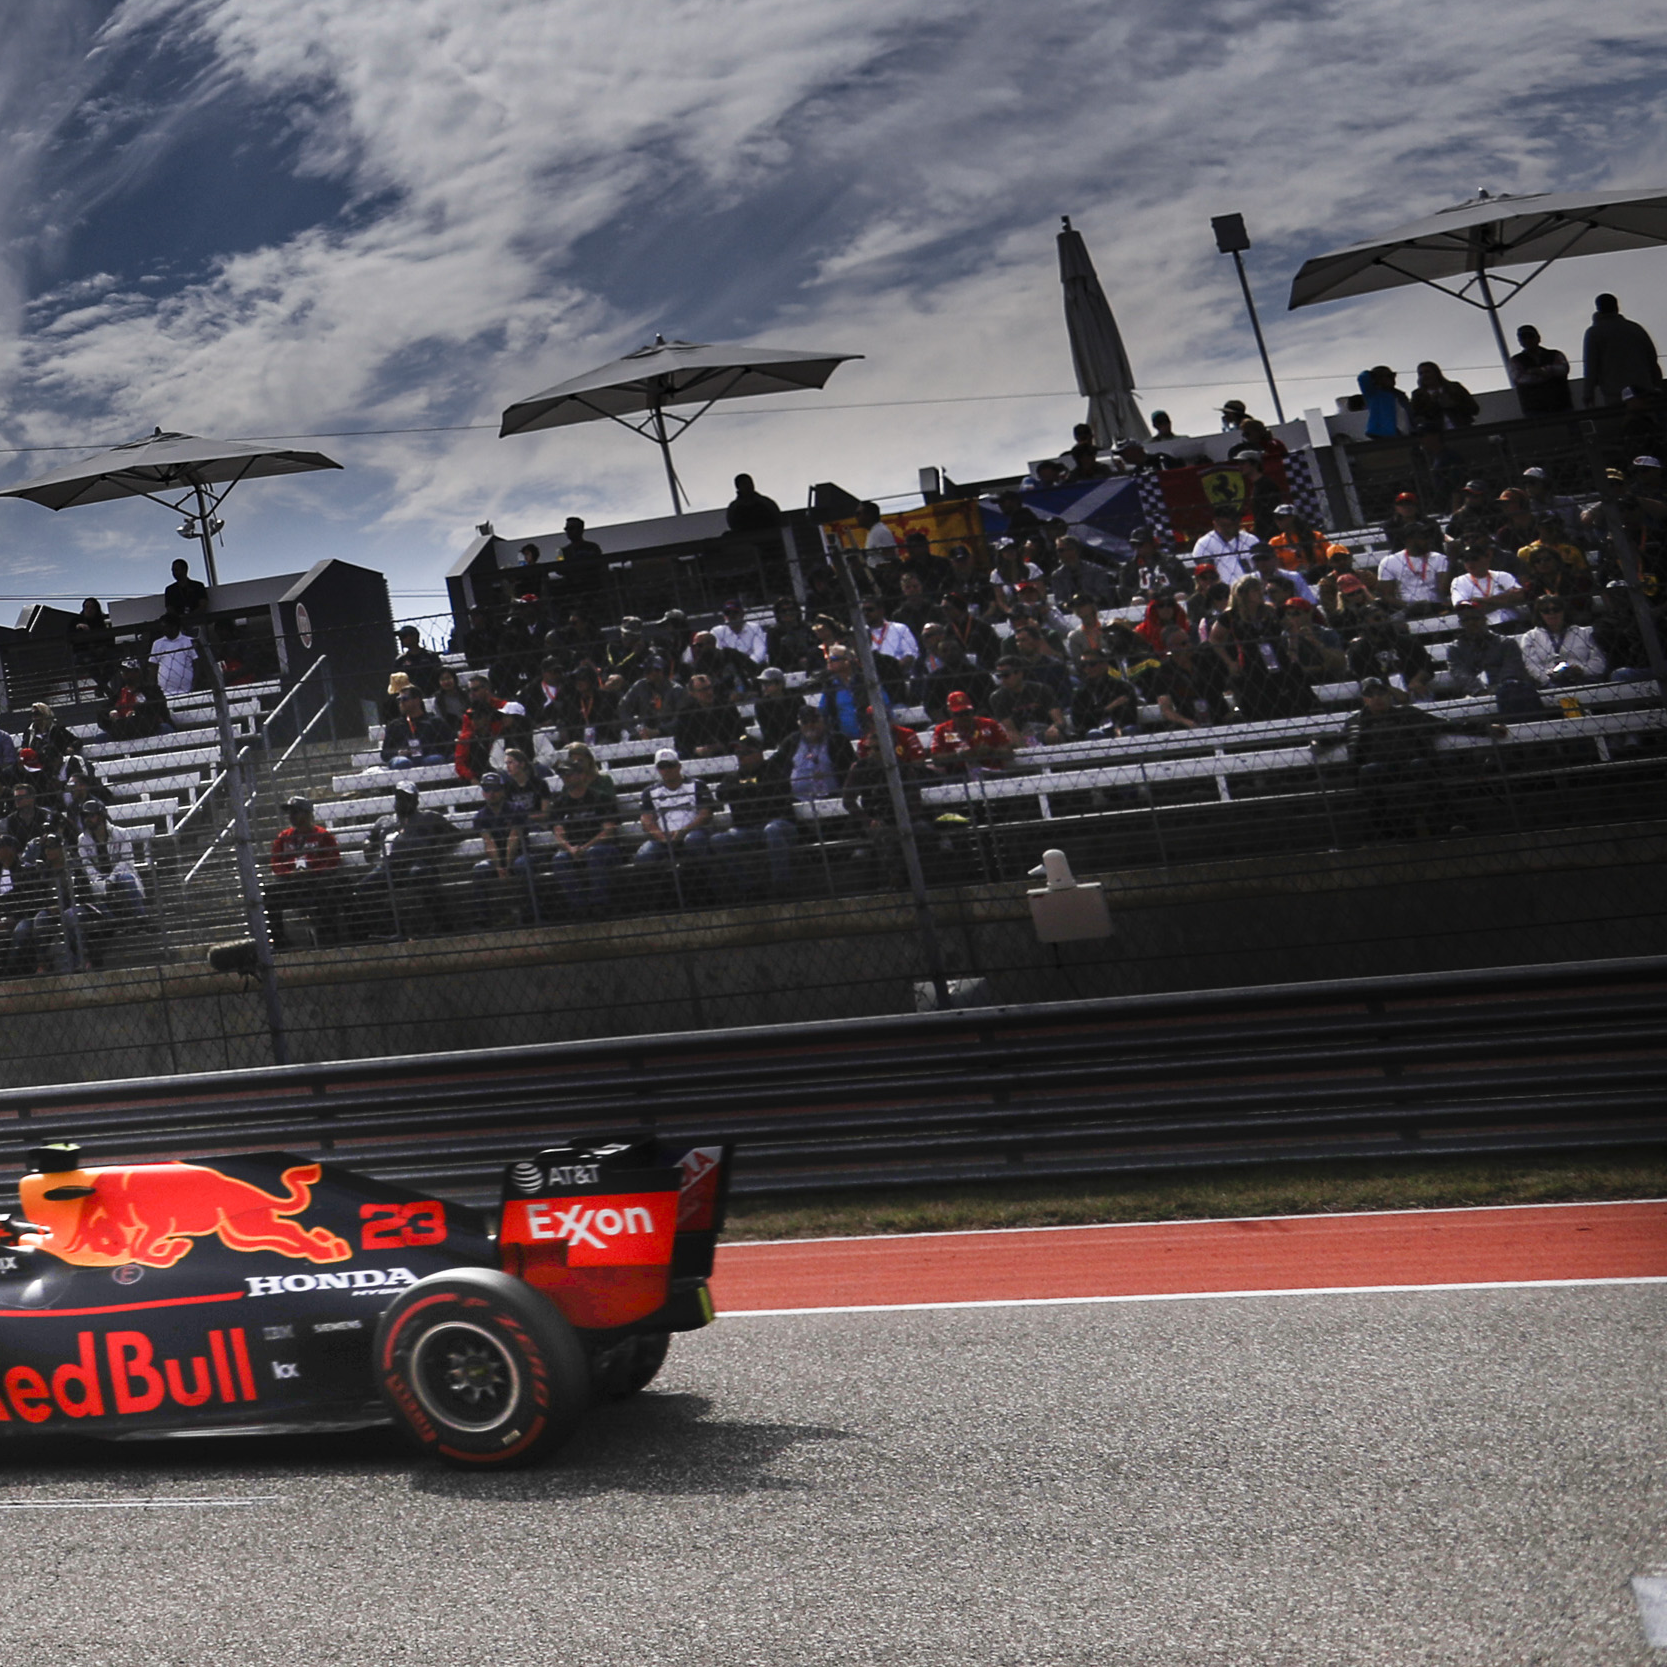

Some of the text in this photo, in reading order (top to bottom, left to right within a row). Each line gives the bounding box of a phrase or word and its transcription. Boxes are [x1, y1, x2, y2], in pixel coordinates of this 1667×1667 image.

[548, 1164, 600, 1186] AT&T
[359, 1200, 447, 1250] 23
[526, 1204, 654, 1249] Exxon
[244, 1267, 419, 1297] HONDA
